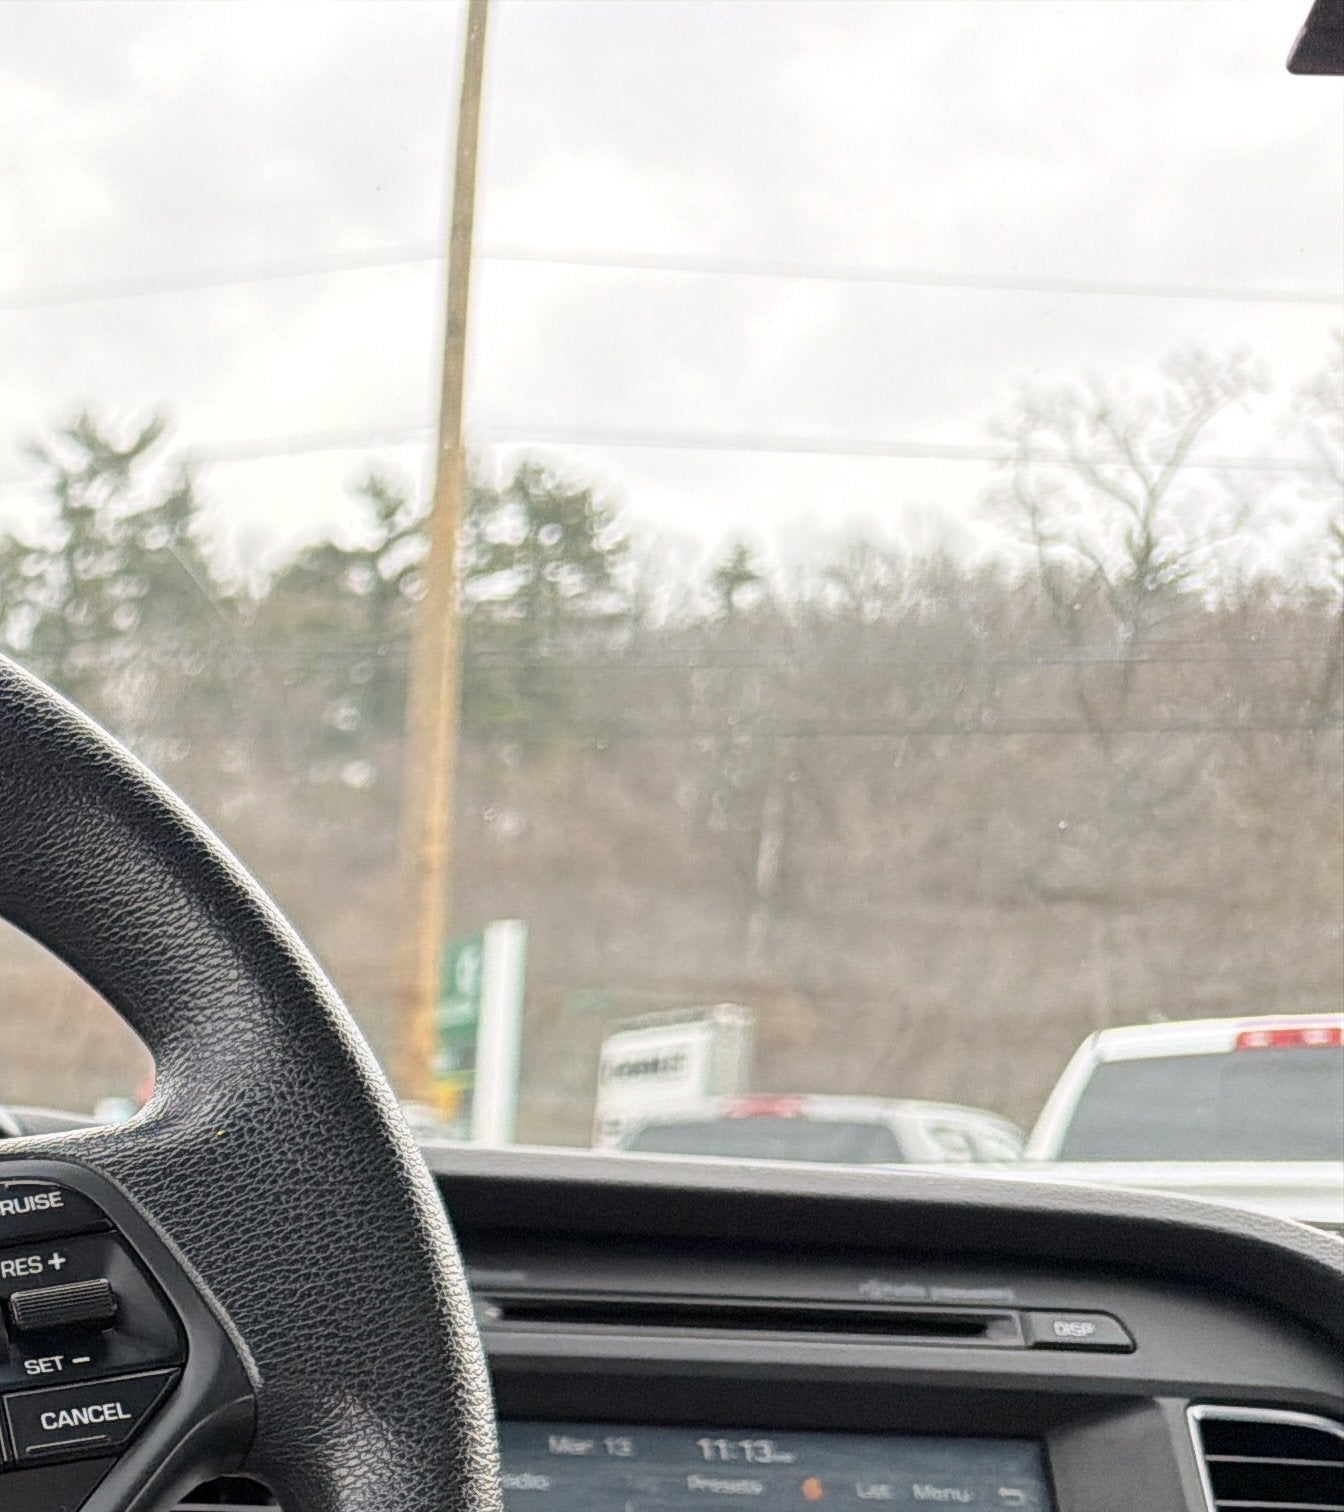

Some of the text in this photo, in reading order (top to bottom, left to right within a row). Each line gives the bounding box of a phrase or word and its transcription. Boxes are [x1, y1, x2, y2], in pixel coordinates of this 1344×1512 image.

[1053, 1321, 1096, 1337] DISP
[41, 1402, 132, 1430] CANCEL
[604, 1436, 633, 1457] 13
